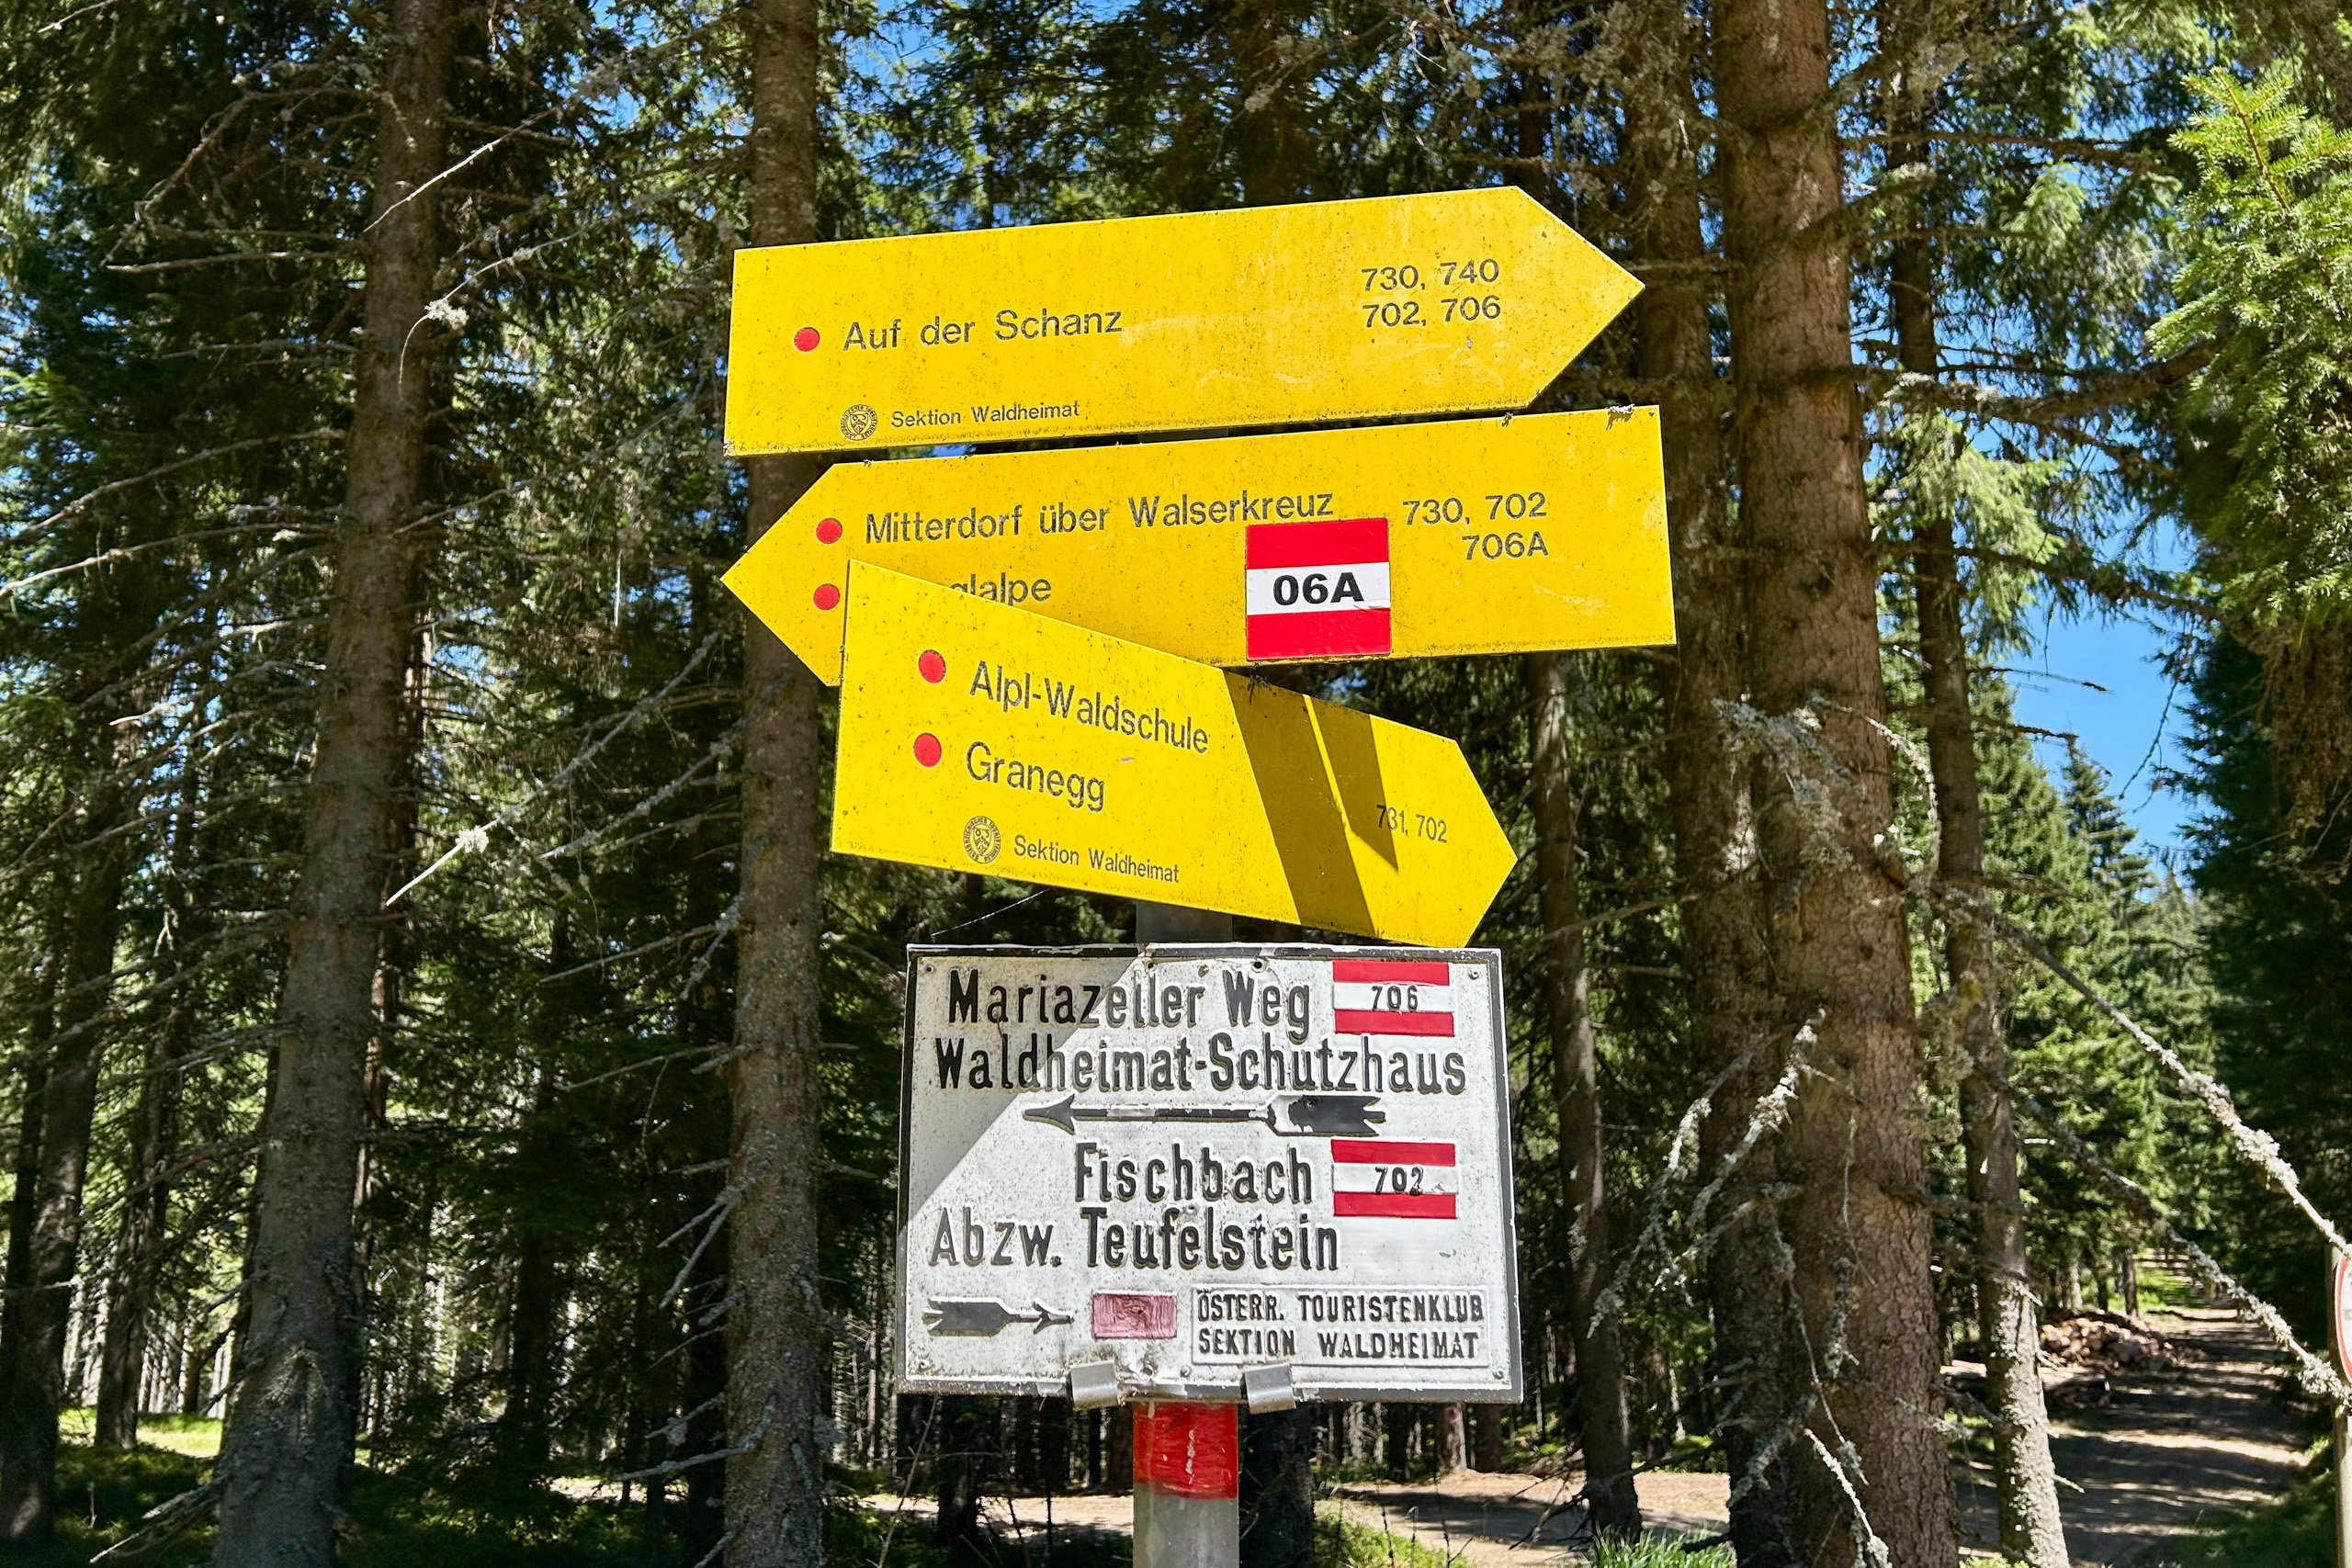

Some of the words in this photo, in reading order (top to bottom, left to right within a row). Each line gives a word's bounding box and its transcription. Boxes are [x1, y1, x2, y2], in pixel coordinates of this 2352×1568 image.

[1361, 265, 1426, 292] 730,
[1440, 258, 1499, 286] 740
[842, 317, 901, 352] Auf
[920, 314, 976, 346] der
[994, 308, 1123, 341] Schanz
[1363, 301, 1426, 328] 702,
[1441, 295, 1501, 322] 706
[890, 409, 962, 429] Sektion
[971, 400, 1080, 423] Waldheimat
[865, 504, 1023, 544] Mitterdorf
[1039, 502, 1111, 534] über
[1127, 491, 1333, 528] Walserkreuz
[1403, 497, 1471, 526] 730,
[1485, 491, 1547, 521] 702
[1461, 531, 1549, 560] 706A
[1273, 571, 1364, 605] 06A
[969, 660, 1209, 754] Alpl-Waldschule
[966, 740, 1105, 813] Granegg
[1376, 804, 1408, 837] 731,
[1416, 814, 1448, 843] 702
[1013, 834, 1080, 866] Sektion
[1089, 848, 1180, 884] Waldheimat
[949, 969, 1205, 1028] Mariazeller
[1224, 970, 1310, 1043] Weg
[1371, 984, 1419, 1011] 706
[935, 1030, 1467, 1094] Waldheimat-Schutzhaus
[1075, 1140, 1314, 1202] Fischbach
[1374, 1166, 1426, 1195] 702
[930, 1206, 1062, 1268] Abzw.
[1080, 1206, 1340, 1270] Teufelstein
[1197, 1289, 1285, 1322] ÖSTERR.
[1297, 1292, 1486, 1323] TOURISTENKLUB
[1197, 1327, 1296, 1357] SEKTION
[1318, 1330, 1481, 1359] WALDHEIMAT
